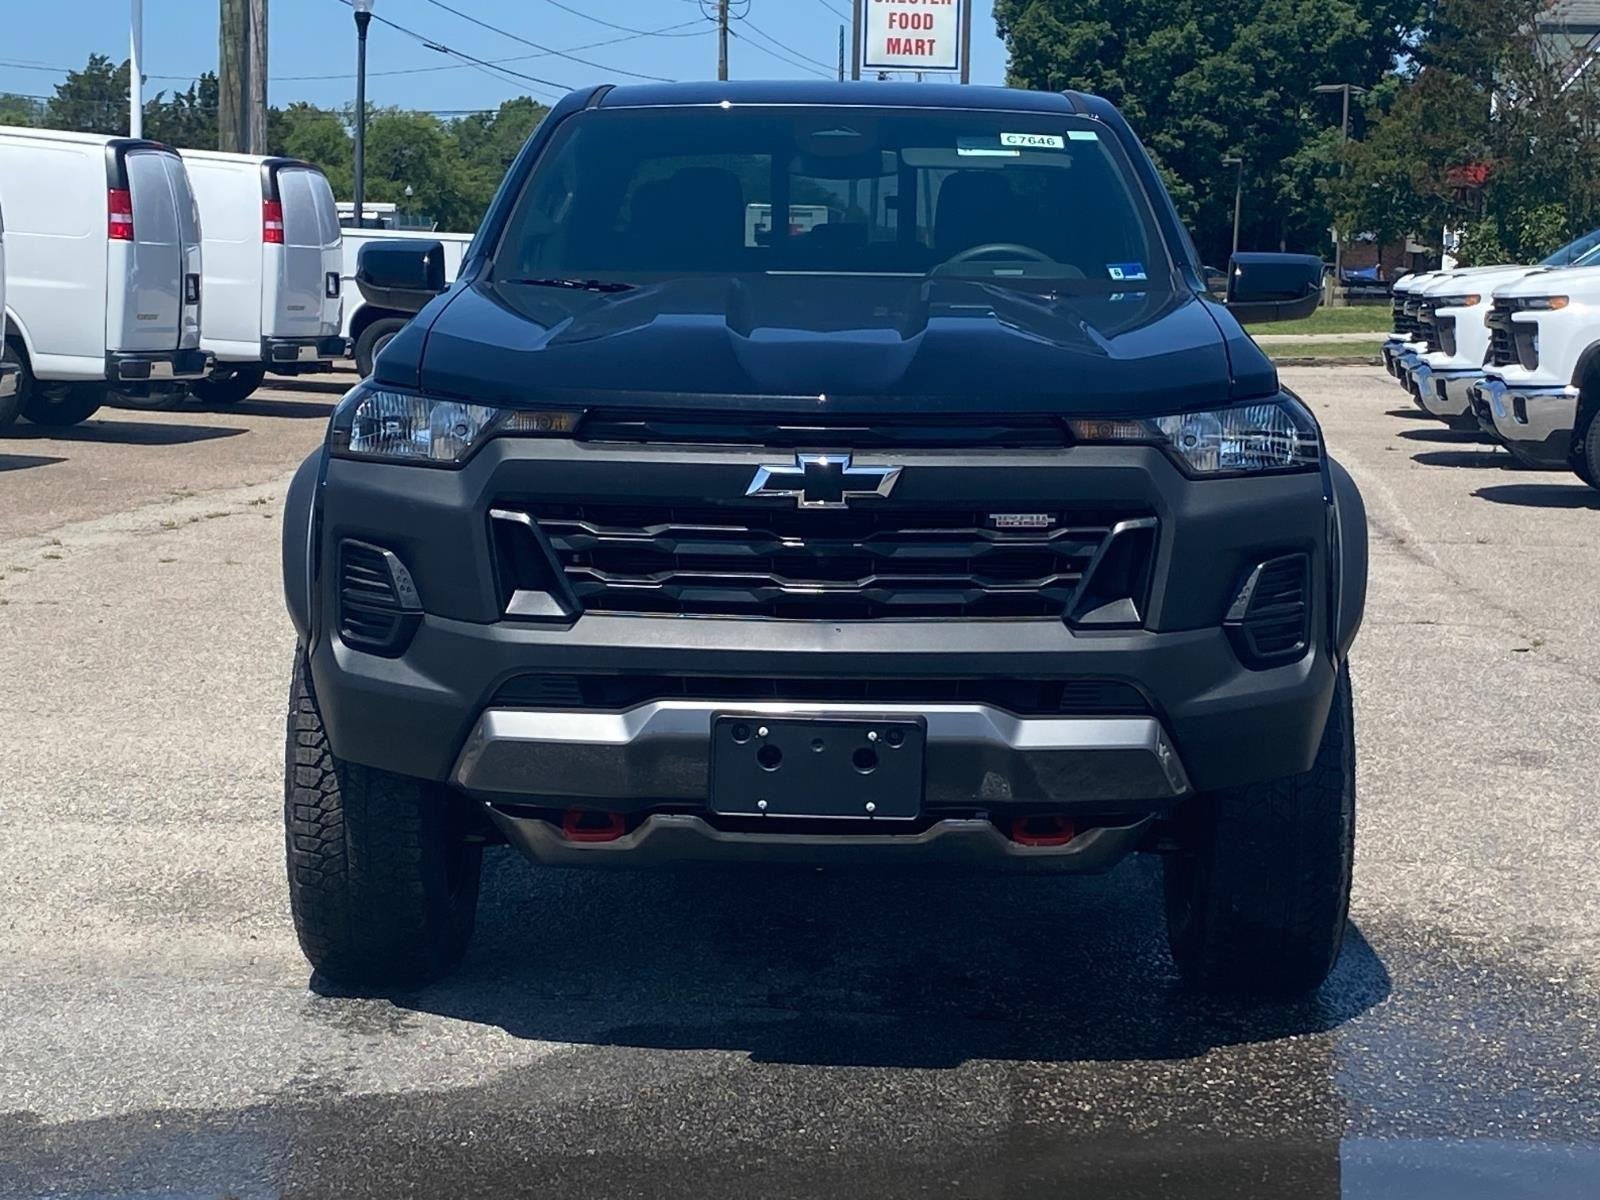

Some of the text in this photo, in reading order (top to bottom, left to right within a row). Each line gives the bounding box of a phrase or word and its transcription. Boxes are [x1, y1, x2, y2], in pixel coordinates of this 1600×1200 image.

[888, 12, 934, 30] FOOD
[886, 38, 936, 56] MART
[1006, 135, 1056, 146] C7646
